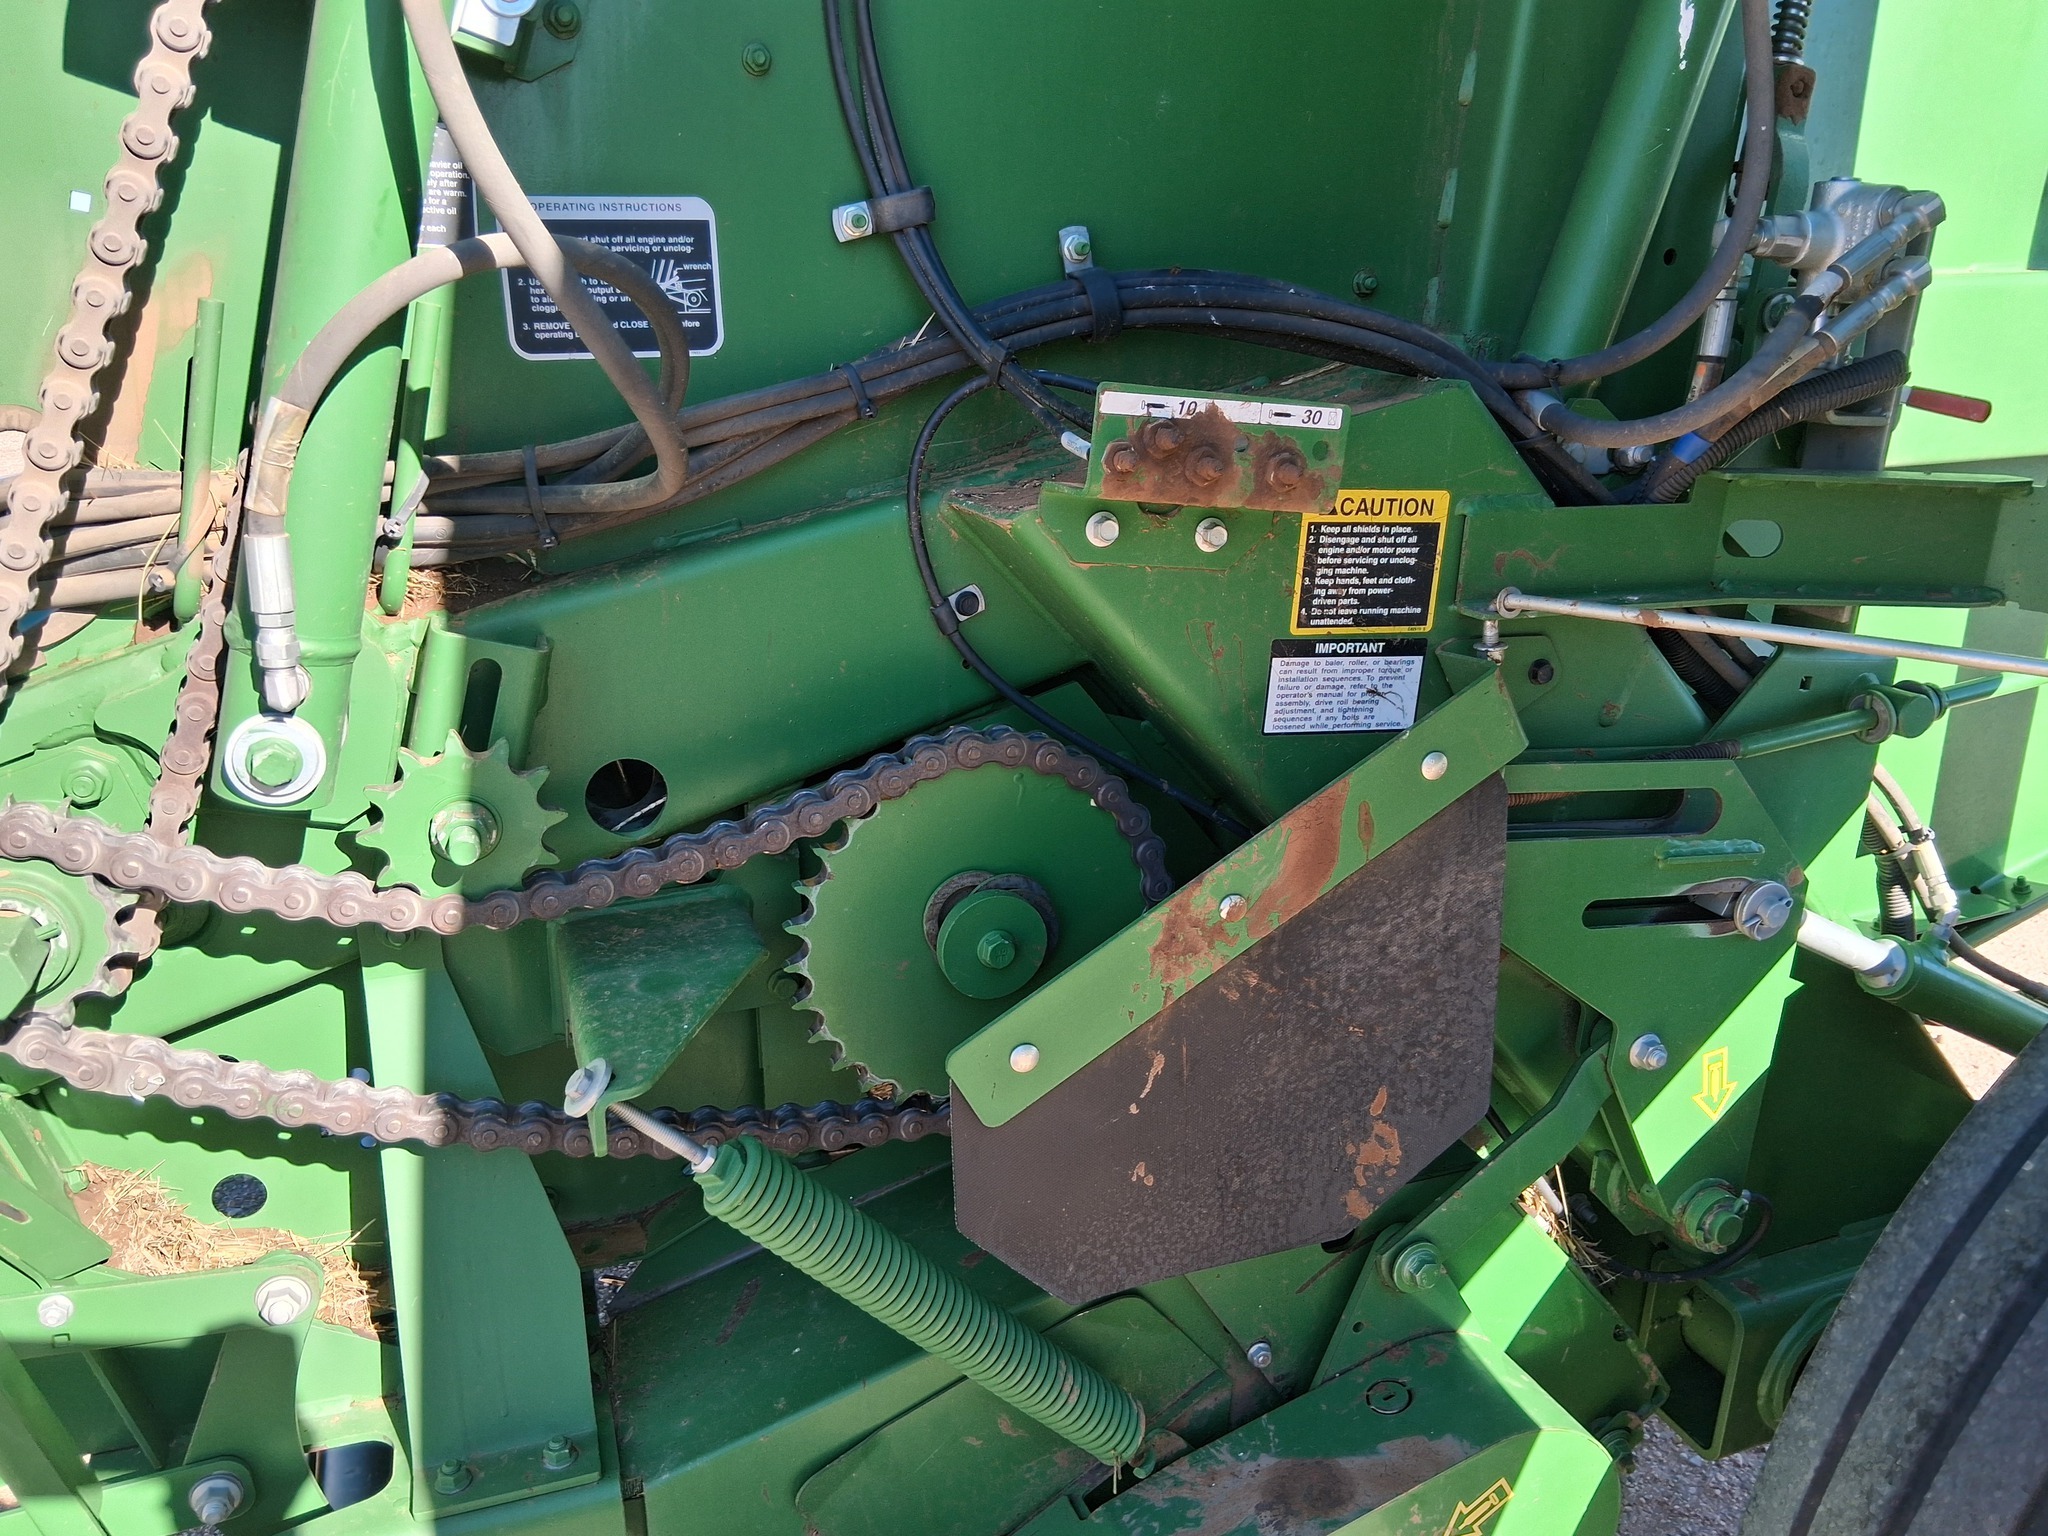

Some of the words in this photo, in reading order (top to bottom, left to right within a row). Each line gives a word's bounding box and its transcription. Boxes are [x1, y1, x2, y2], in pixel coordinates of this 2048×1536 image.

[430, 171, 470, 179] operation.
[439, 179, 458, 187] after
[447, 207, 456, 215] oil
[531, 203, 595, 212] OPERATING
[600, 203, 681, 212] INSTRUCTIONS
[591, 236, 609, 244] shut
[638, 236, 665, 245] engine
[612, 244, 650, 253] servicing
[664, 245, 694, 253] unclog-
[534, 322, 571, 330] REMOVE
[620, 320, 649, 328] CLOSE
[535, 331, 573, 340] operating
[1178, 400, 1197, 416] 10
[1301, 409, 1323, 426] 30
[1340, 498, 1434, 517] CAUTION
[1320, 525, 1340, 534] Keep
[1342, 525, 1351, 533] all
[1353, 525, 1381, 533] shields
[1382, 525, 1390, 533] in
[1391, 526, 1413, 534] place.
[1319, 535, 1360, 544] Disengage
[1318, 546, 1344, 555] engine
[1346, 546, 1370, 554] and/or
[1372, 546, 1394, 554] motor
[1396, 547, 1419, 555] power
[1317, 556, 1342, 564] before
[1343, 556, 1378, 565] servicing
[1389, 557, 1418, 566] unclog-
[1316, 567, 1333, 576] ging
[1335, 567, 1369, 575] machine.
[1315, 577, 1334, 586] Keep
[1336, 577, 1361, 585] hands,
[1314, 588, 1326, 596] ing
[1348, 587, 1366, 595] from
[1368, 588, 1393, 596] power-
[1313, 597, 1336, 605] driven
[1338, 598, 1360, 606] parts.
[1338, 607, 1358, 615] leave
[1359, 607, 1388, 616] running
[1390, 607, 1421, 615] machine
[1311, 617, 1354, 625] unattended.
[1315, 642, 1385, 653] IMPORTANT
[1342, 667, 1374, 675] improper
[1378, 667, 1401, 675] torque
[1316, 683, 1345, 691] damage,
[1276, 691, 1312, 699] operator's
[1275, 699, 1311, 707] assembly,
[1352, 698, 1379, 706] bearing
[1274, 707, 1316, 715] adjustment,
[1332, 722, 1371, 730] performing
